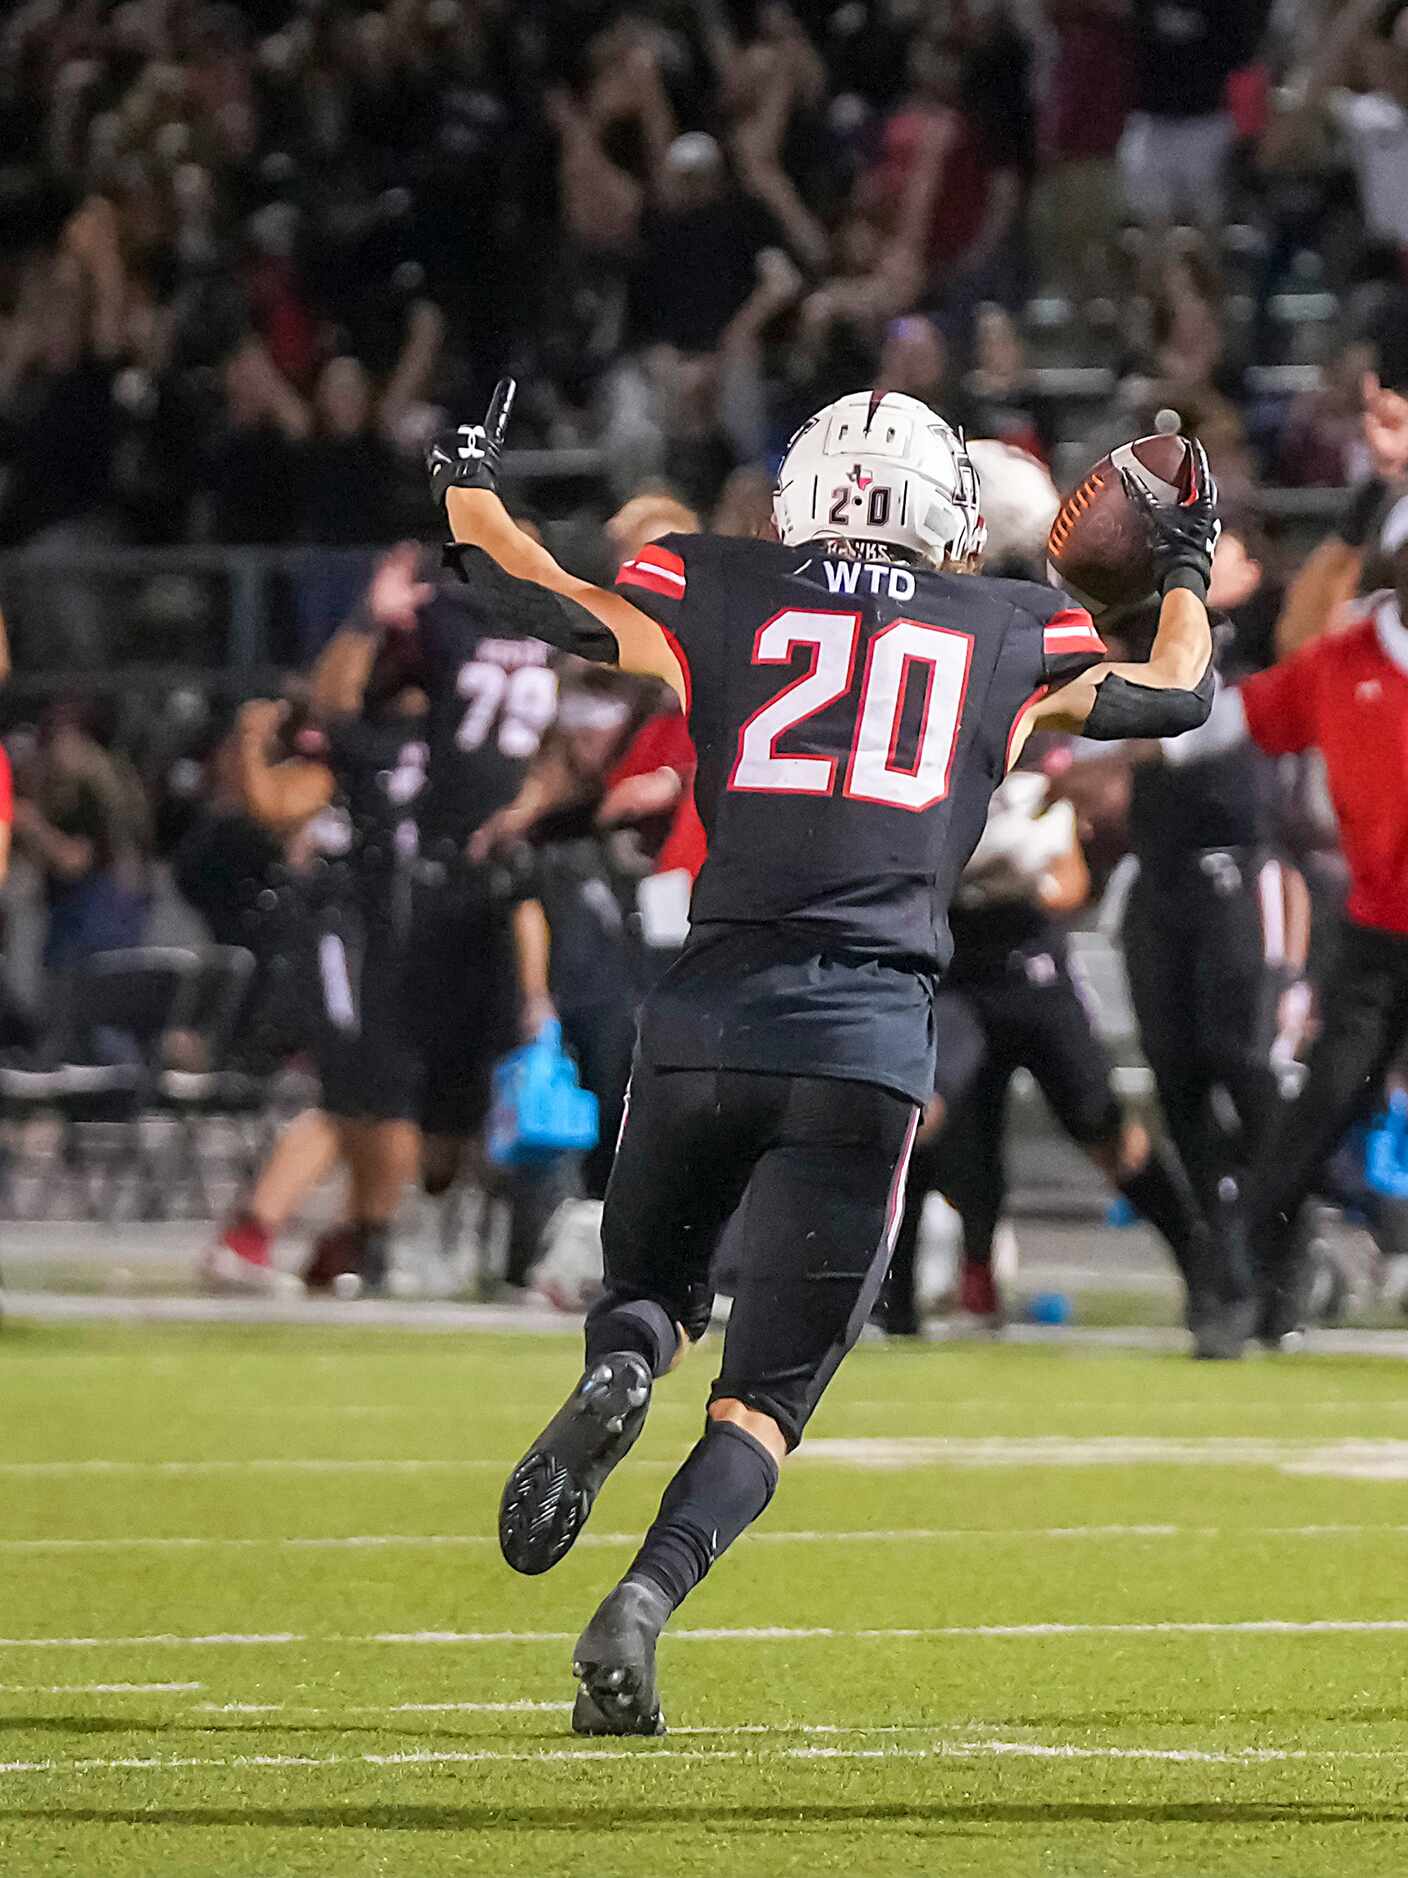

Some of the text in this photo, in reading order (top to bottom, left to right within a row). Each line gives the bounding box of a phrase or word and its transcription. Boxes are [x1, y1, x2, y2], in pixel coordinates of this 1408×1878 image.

[829, 486, 891, 526] 20
[823, 560, 916, 601] WTD
[727, 606, 975, 813] 20
